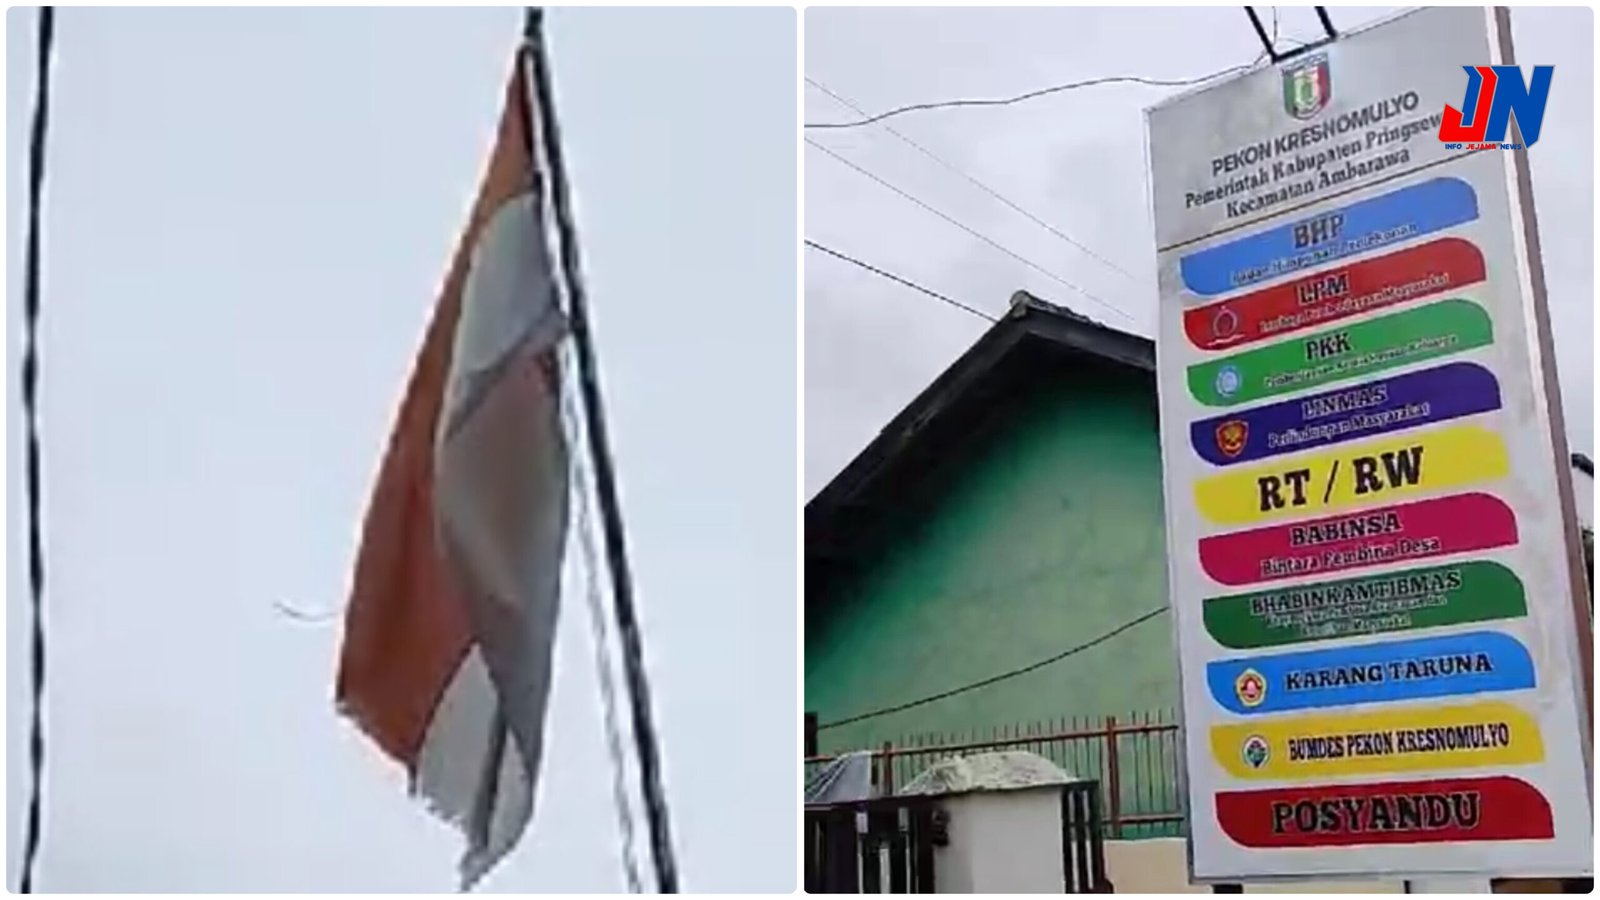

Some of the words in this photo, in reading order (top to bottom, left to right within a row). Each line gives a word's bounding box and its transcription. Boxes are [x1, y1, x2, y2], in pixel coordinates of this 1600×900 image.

[1212, 140, 1272, 176] PEKON
[1274, 91, 1420, 154] KRESNOMULYO
[1185, 166, 1270, 208] Pemerintah
[1273, 142, 1363, 181] Kabupaten
[1364, 113, 1442, 150] Pringsew
[1226, 182, 1315, 219] Kecamatan
[1318, 148, 1411, 190] Ambarawa
[1294, 213, 1345, 249] BHP
[1299, 271, 1350, 305] LPM
[1306, 332, 1352, 360] PKK
[1303, 385, 1388, 420] LINMAS
[1259, 468, 1310, 512] RT
[1324, 460, 1340, 504] /
[1353, 446, 1424, 494] RW
[1292, 512, 1402, 546] BABINSA
[1262, 555, 1318, 576] Bintara
[1399, 537, 1440, 556] Desa
[1251, 571, 1461, 615] BHABINKAMTIBMAS
[1286, 664, 1383, 691] KARANG
[1388, 653, 1493, 682] TARUNA
[1288, 735, 1344, 761] BUMDES
[1347, 731, 1394, 758] PEKON
[1396, 722, 1510, 752] KRESNOMULYO
[1271, 792, 1480, 834] POSYANDU
